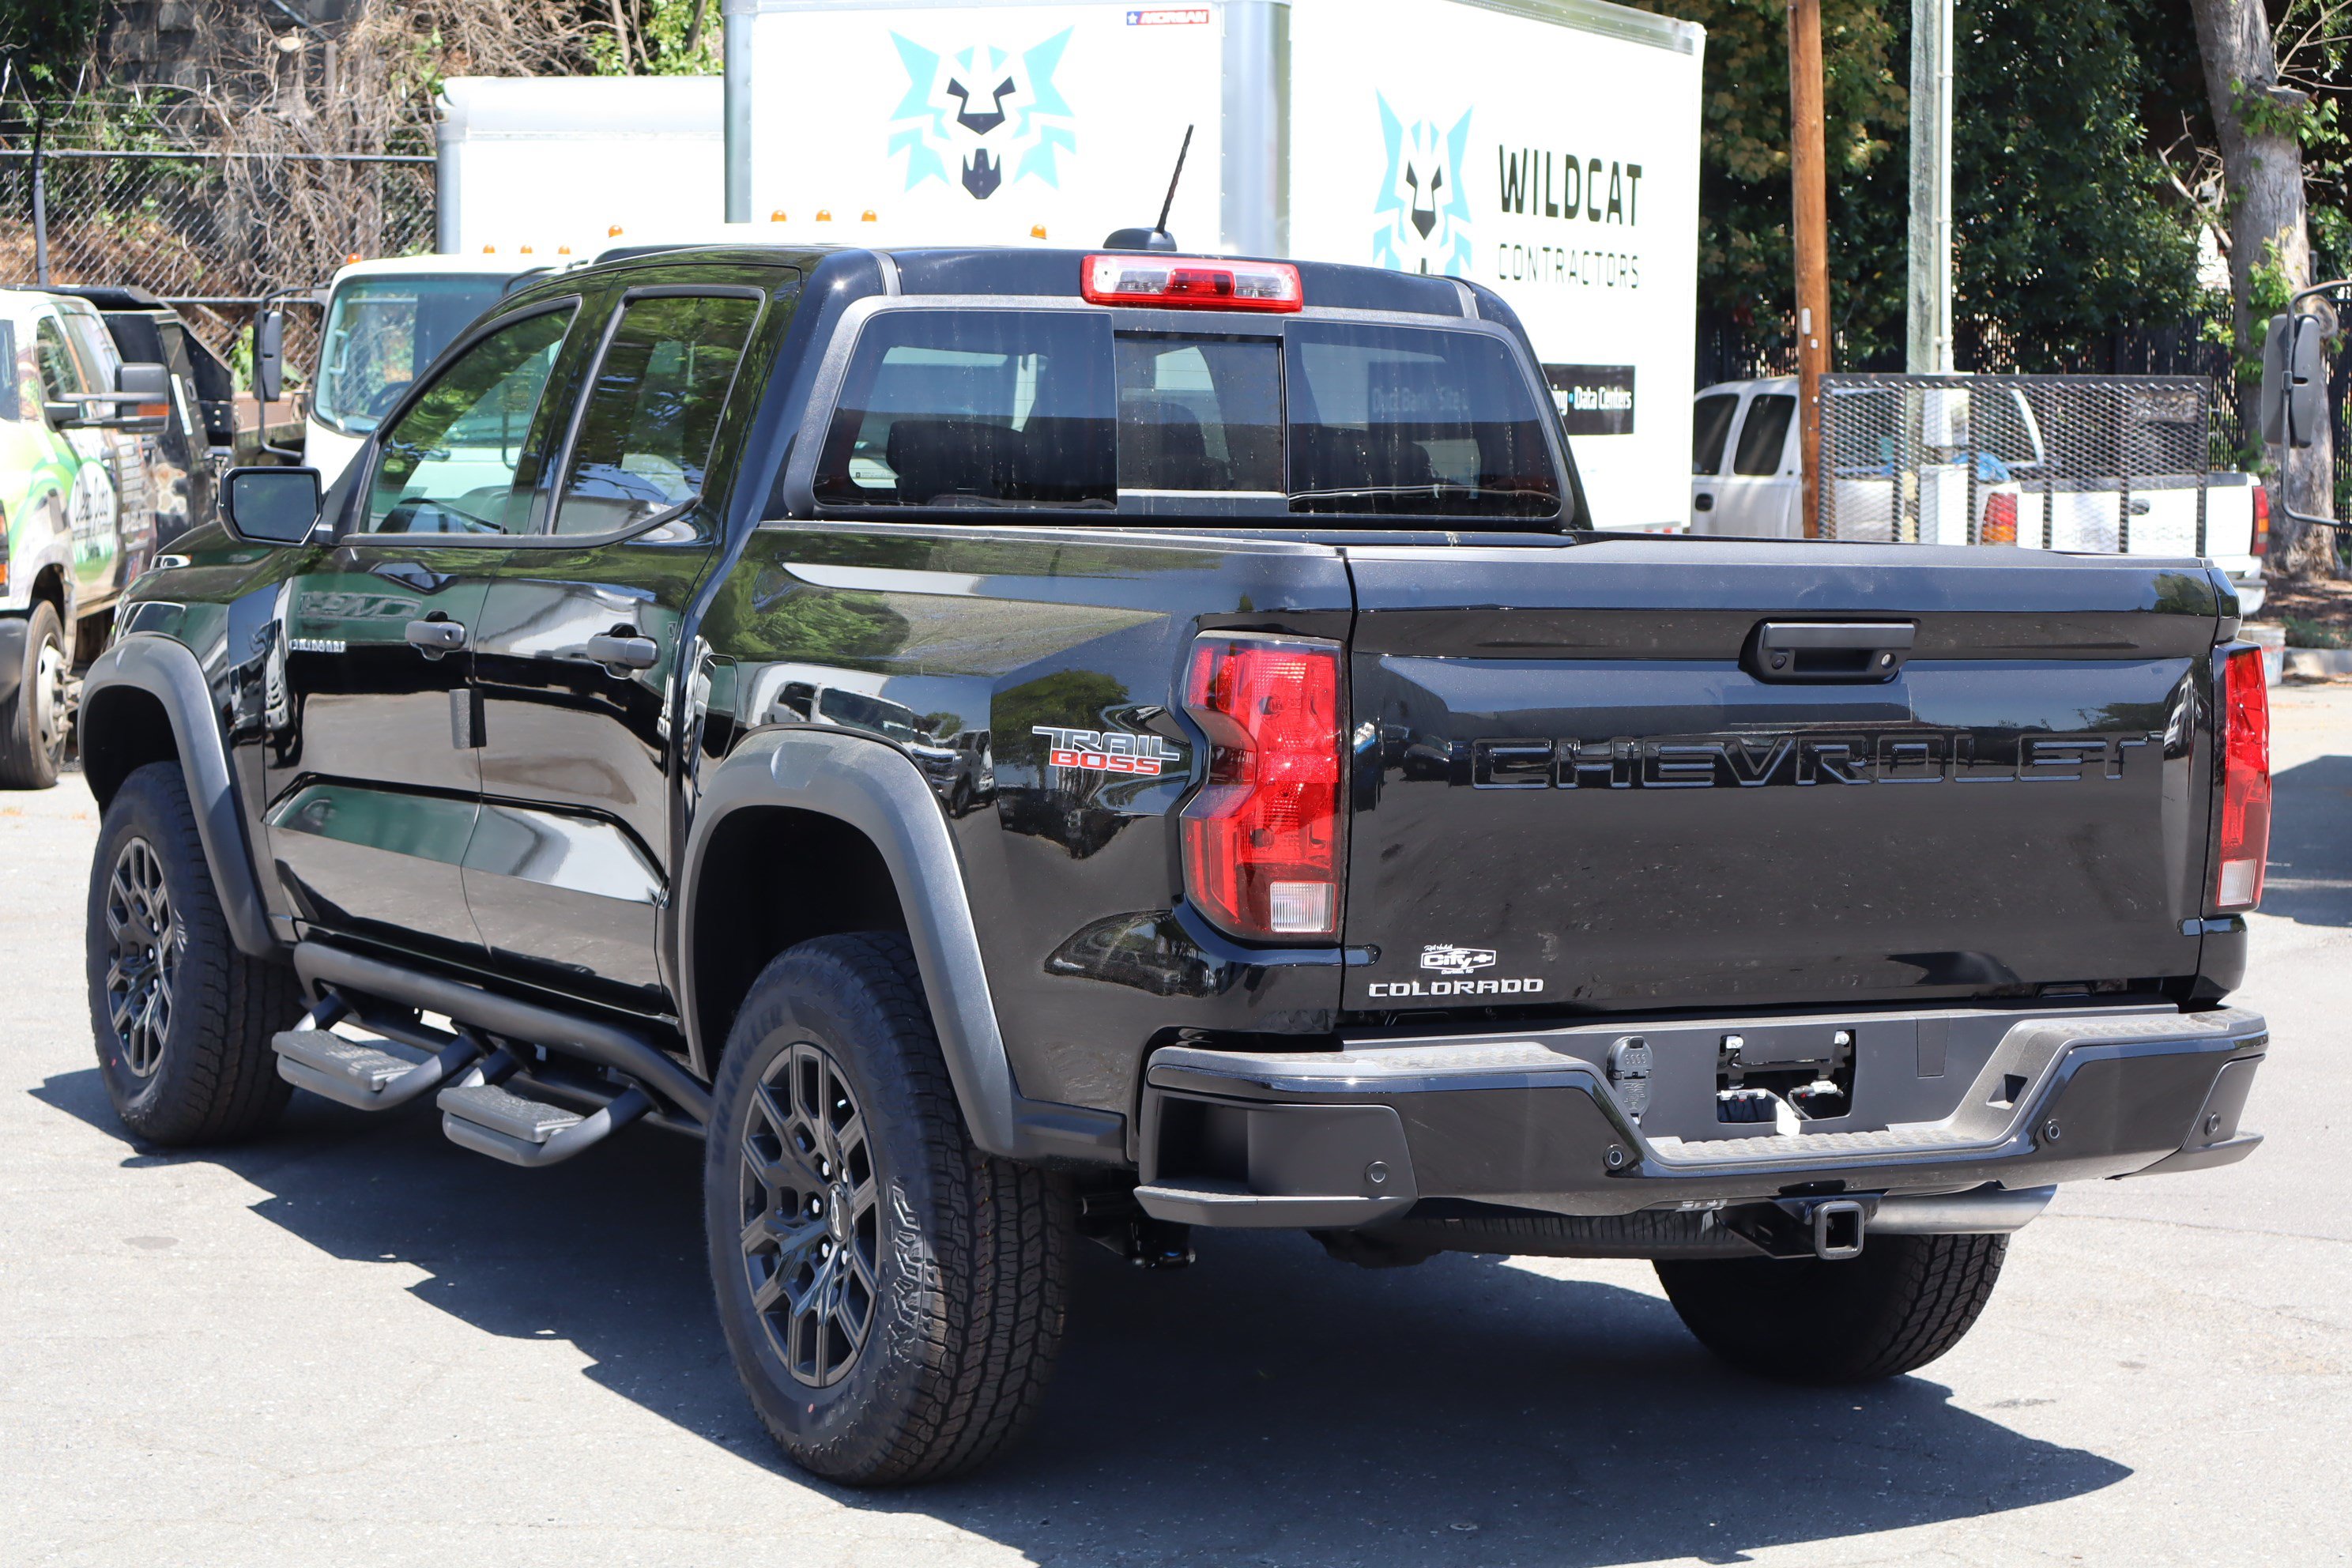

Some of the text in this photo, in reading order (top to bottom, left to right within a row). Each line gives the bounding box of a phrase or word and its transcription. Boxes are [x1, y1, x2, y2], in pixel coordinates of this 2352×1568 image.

[1498, 144, 1642, 227] WILDCAT
[1498, 243, 1639, 289] CONTRACTORS
[1574, 386, 1597, 409] Data
[1598, 386, 1632, 409] Centers
[1032, 726, 1180, 761] TRAIL
[1050, 749, 1162, 776] BOSS
[1472, 733, 2163, 789] CHEVROLET
[1423, 951, 1472, 969] City
[1368, 978, 1544, 997] COLORADO
